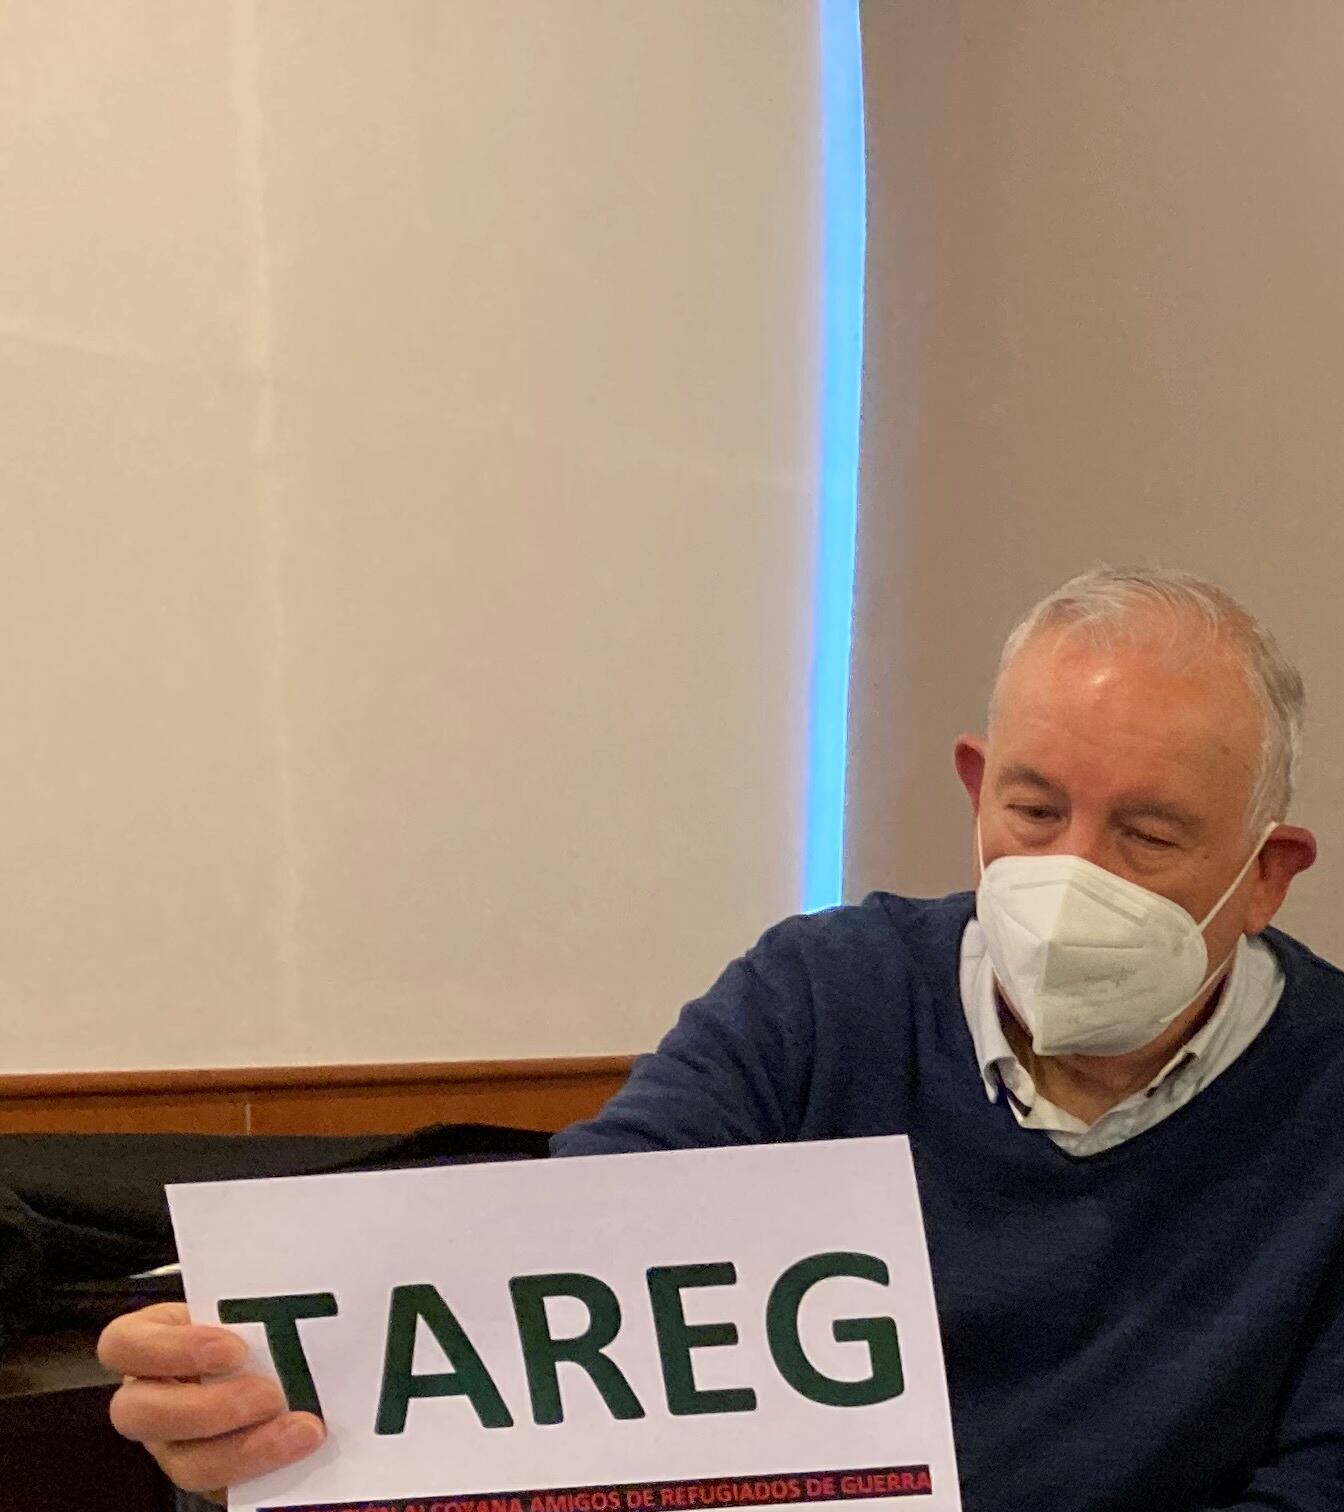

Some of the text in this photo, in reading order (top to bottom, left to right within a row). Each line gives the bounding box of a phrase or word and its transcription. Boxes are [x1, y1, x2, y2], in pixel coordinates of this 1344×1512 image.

[217, 1251, 905, 1437] TAREG
[626, 1490, 654, 1510] DE
[660, 1479, 800, 1507] REFUGIADOS
[806, 1476, 835, 1497] DE
[840, 1471, 931, 1494] GUERRA
